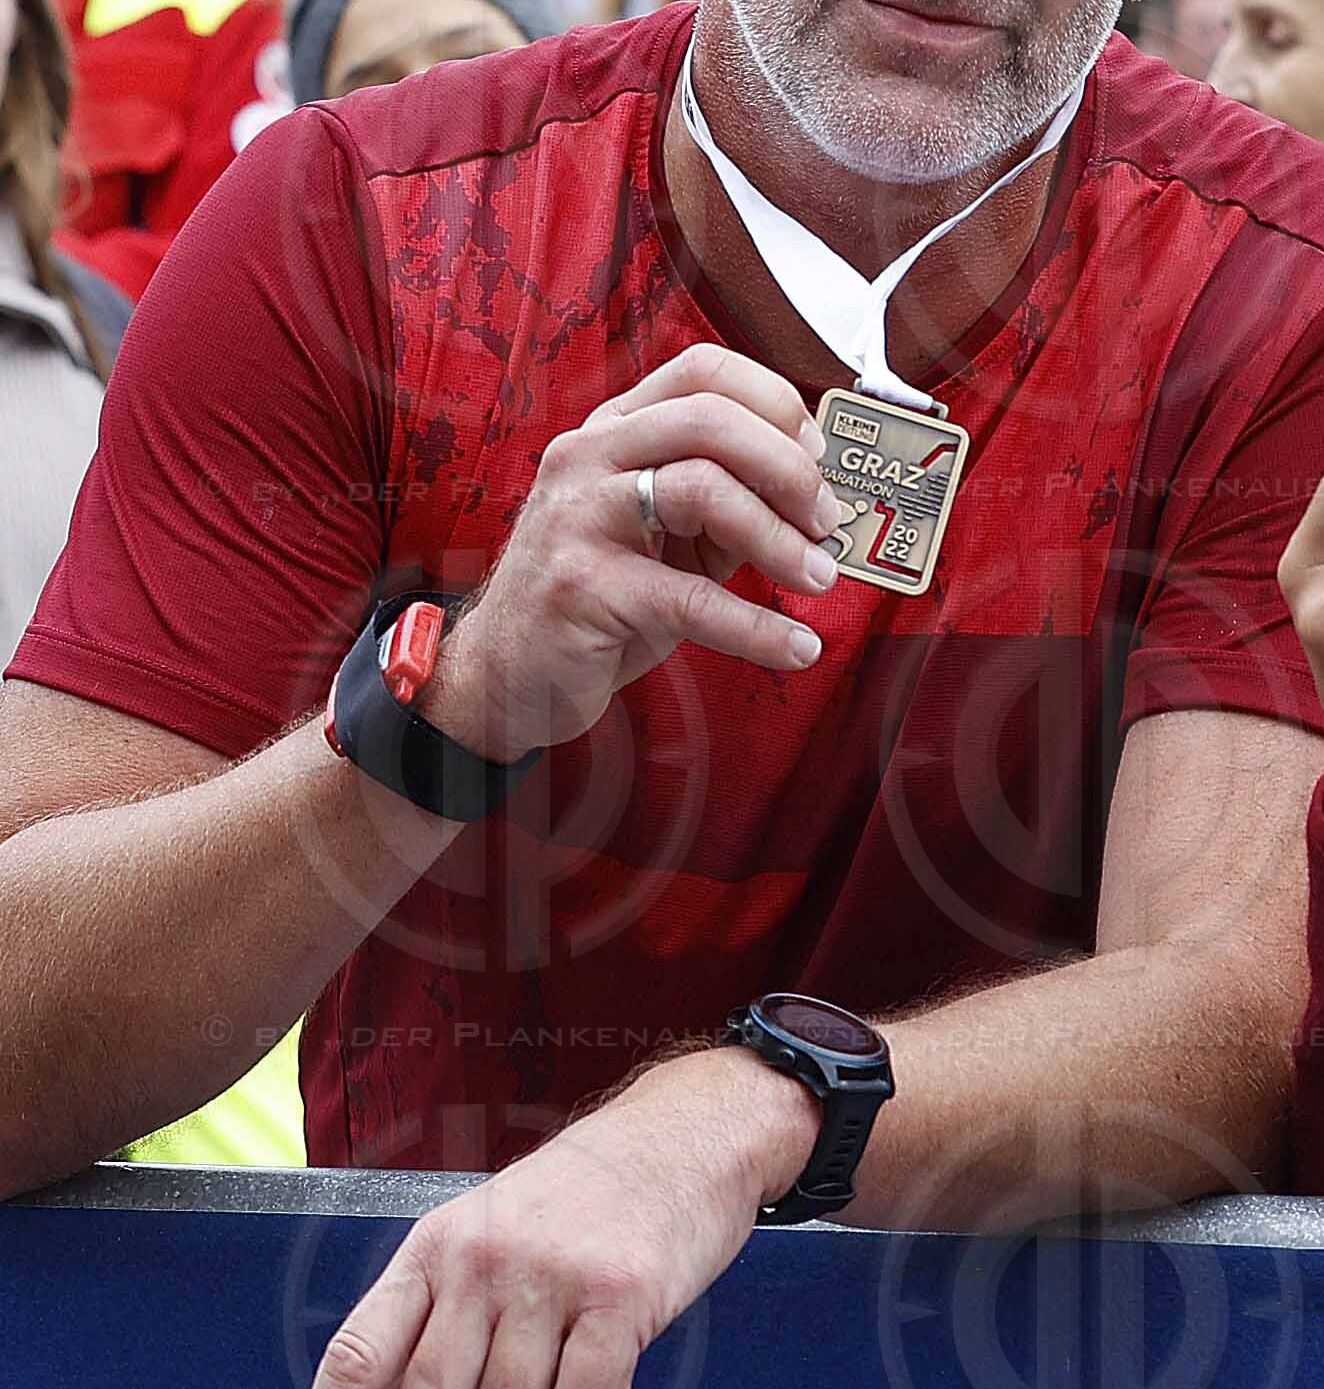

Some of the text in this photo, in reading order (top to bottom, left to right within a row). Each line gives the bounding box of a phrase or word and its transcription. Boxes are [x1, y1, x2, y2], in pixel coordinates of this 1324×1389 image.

[840, 447, 926, 490] GRAZ
[893, 525, 919, 543] 20
[885, 540, 909, 560] 22
